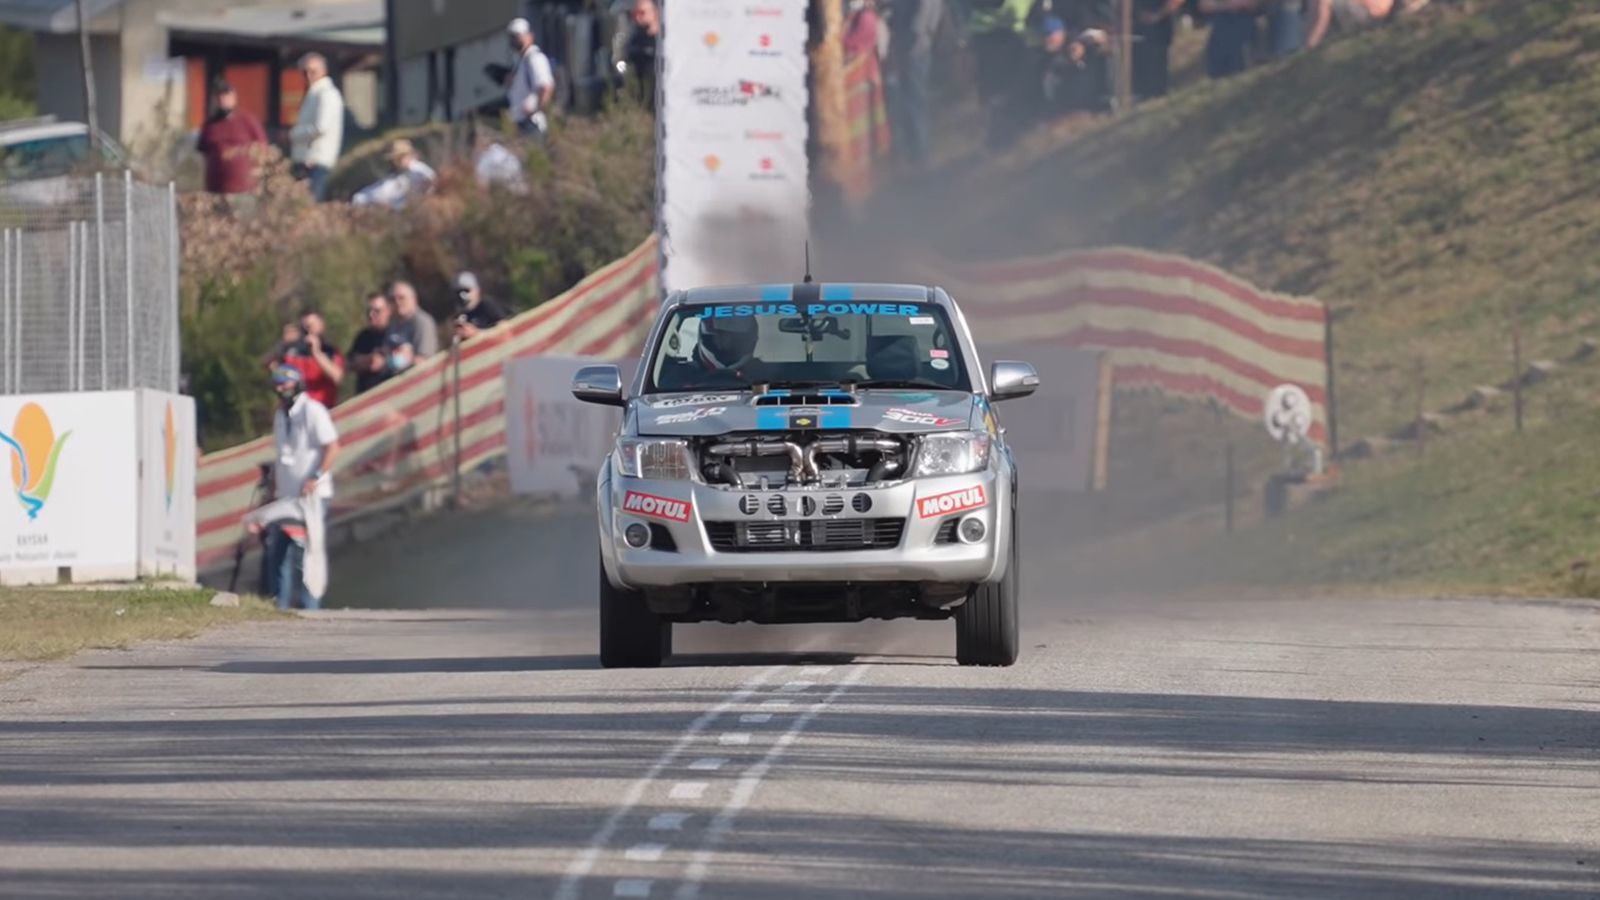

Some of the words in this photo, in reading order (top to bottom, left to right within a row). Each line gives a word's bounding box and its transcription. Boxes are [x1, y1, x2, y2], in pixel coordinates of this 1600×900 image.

[699, 304, 798, 320] JESUS
[808, 303, 920, 316] POWER
[625, 493, 687, 519] MOTUL
[923, 486, 983, 515] MOTUL
